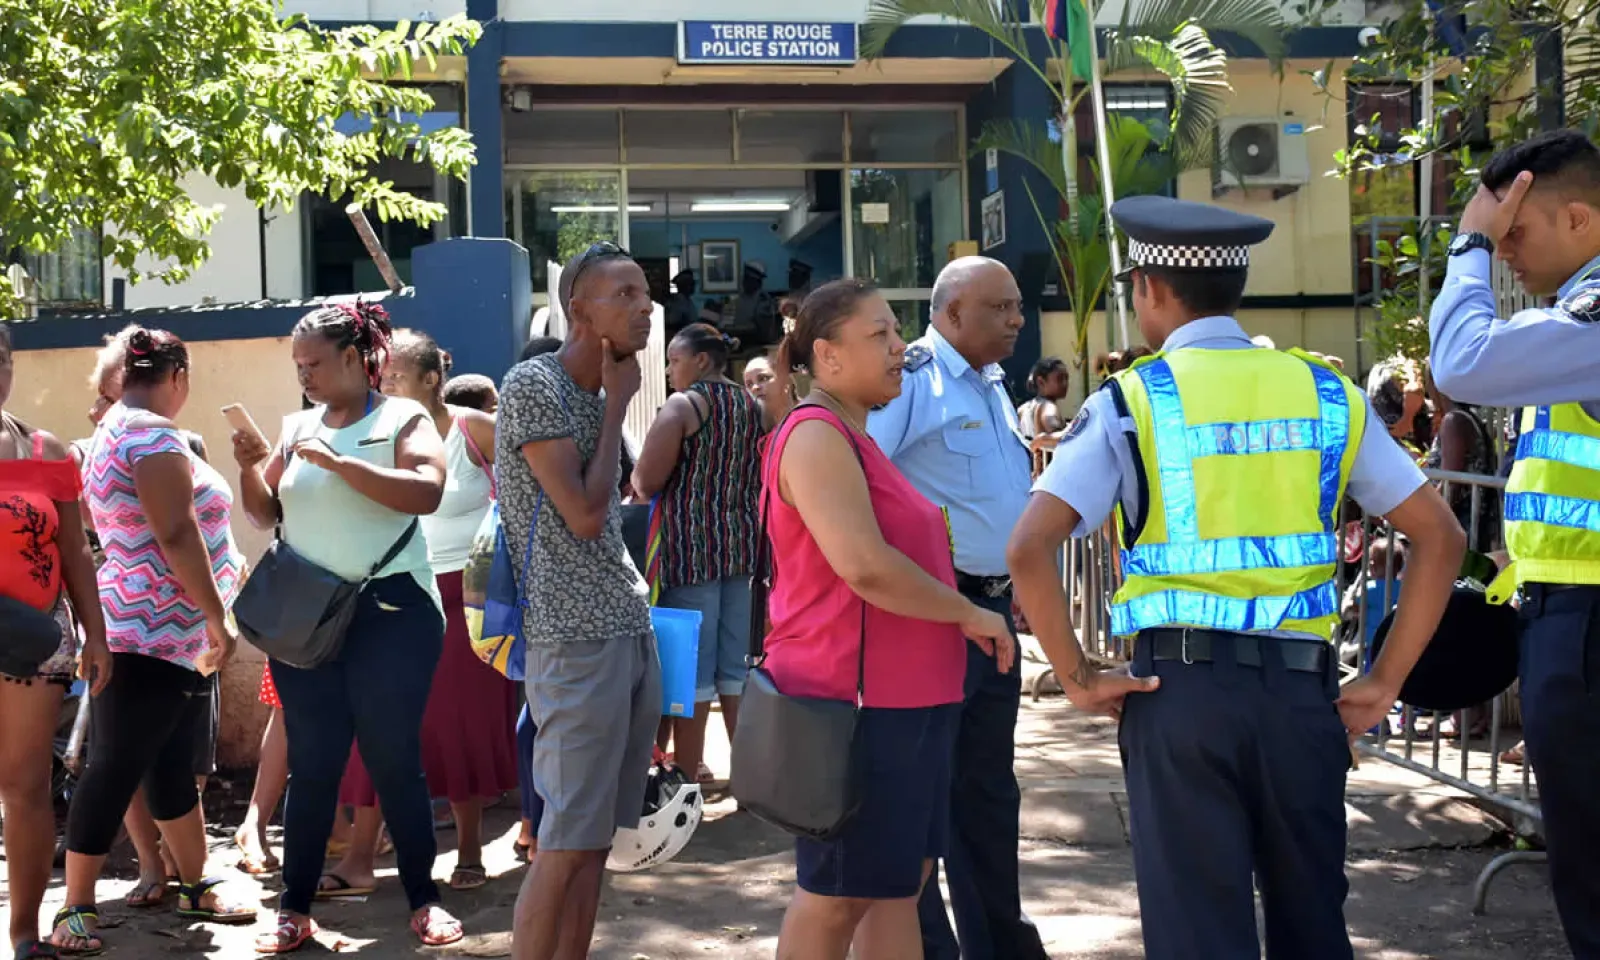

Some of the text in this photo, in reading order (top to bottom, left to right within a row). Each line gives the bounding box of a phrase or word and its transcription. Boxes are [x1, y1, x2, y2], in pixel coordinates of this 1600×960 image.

[711, 24, 832, 39] TERRE ROUGE
[701, 41, 840, 56] POLICE STATION
[1215, 423, 1304, 450] POLICE
